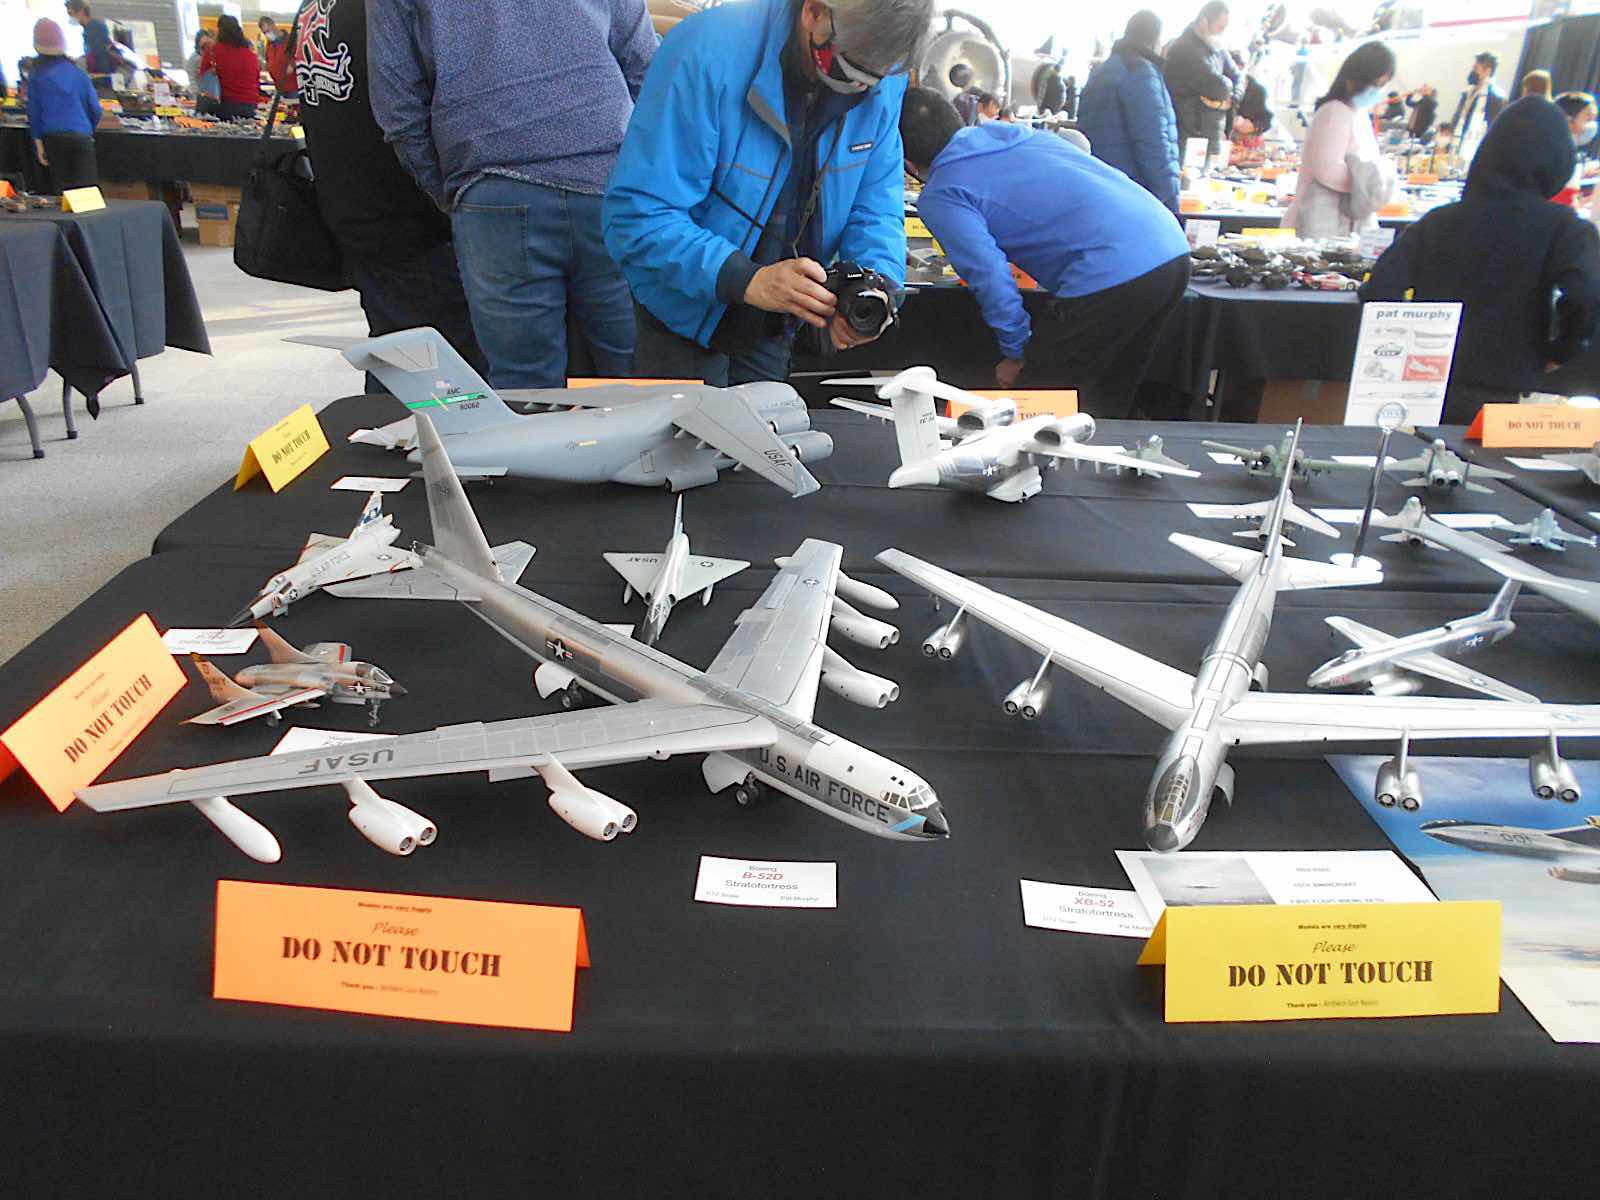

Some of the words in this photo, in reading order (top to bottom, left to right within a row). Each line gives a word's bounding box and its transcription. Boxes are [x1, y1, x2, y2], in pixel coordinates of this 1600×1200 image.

[1376, 308, 1399, 319] pat
[1402, 308, 1454, 320] murphy
[1508, 420, 1522, 431] DO
[1525, 420, 1544, 431] NOT
[763, 449, 793, 467] USAF
[64, 737, 88, 763] DO
[84, 710, 114, 744] NOT
[110, 673, 152, 717] TOUCH
[298, 748, 395, 775] USAF
[794, 764, 820, 791] AIR
[828, 780, 890, 824] FORCE
[742, 871, 783, 881] B-52D
[725, 879, 799, 890] Stratofortress
[1074, 897, 1116, 908] XB-52
[1059, 905, 1135, 919] Stratofortress
[371, 921, 420, 937] Please
[1311, 940, 1357, 954] Please
[281, 935, 322, 962] DO
[330, 939, 392, 968] NOT
[399, 945, 502, 978] TOUCH
[1227, 964, 1266, 987] DO
[1275, 962, 1331, 986] NOT
[1340, 960, 1433, 984] TOUCH
